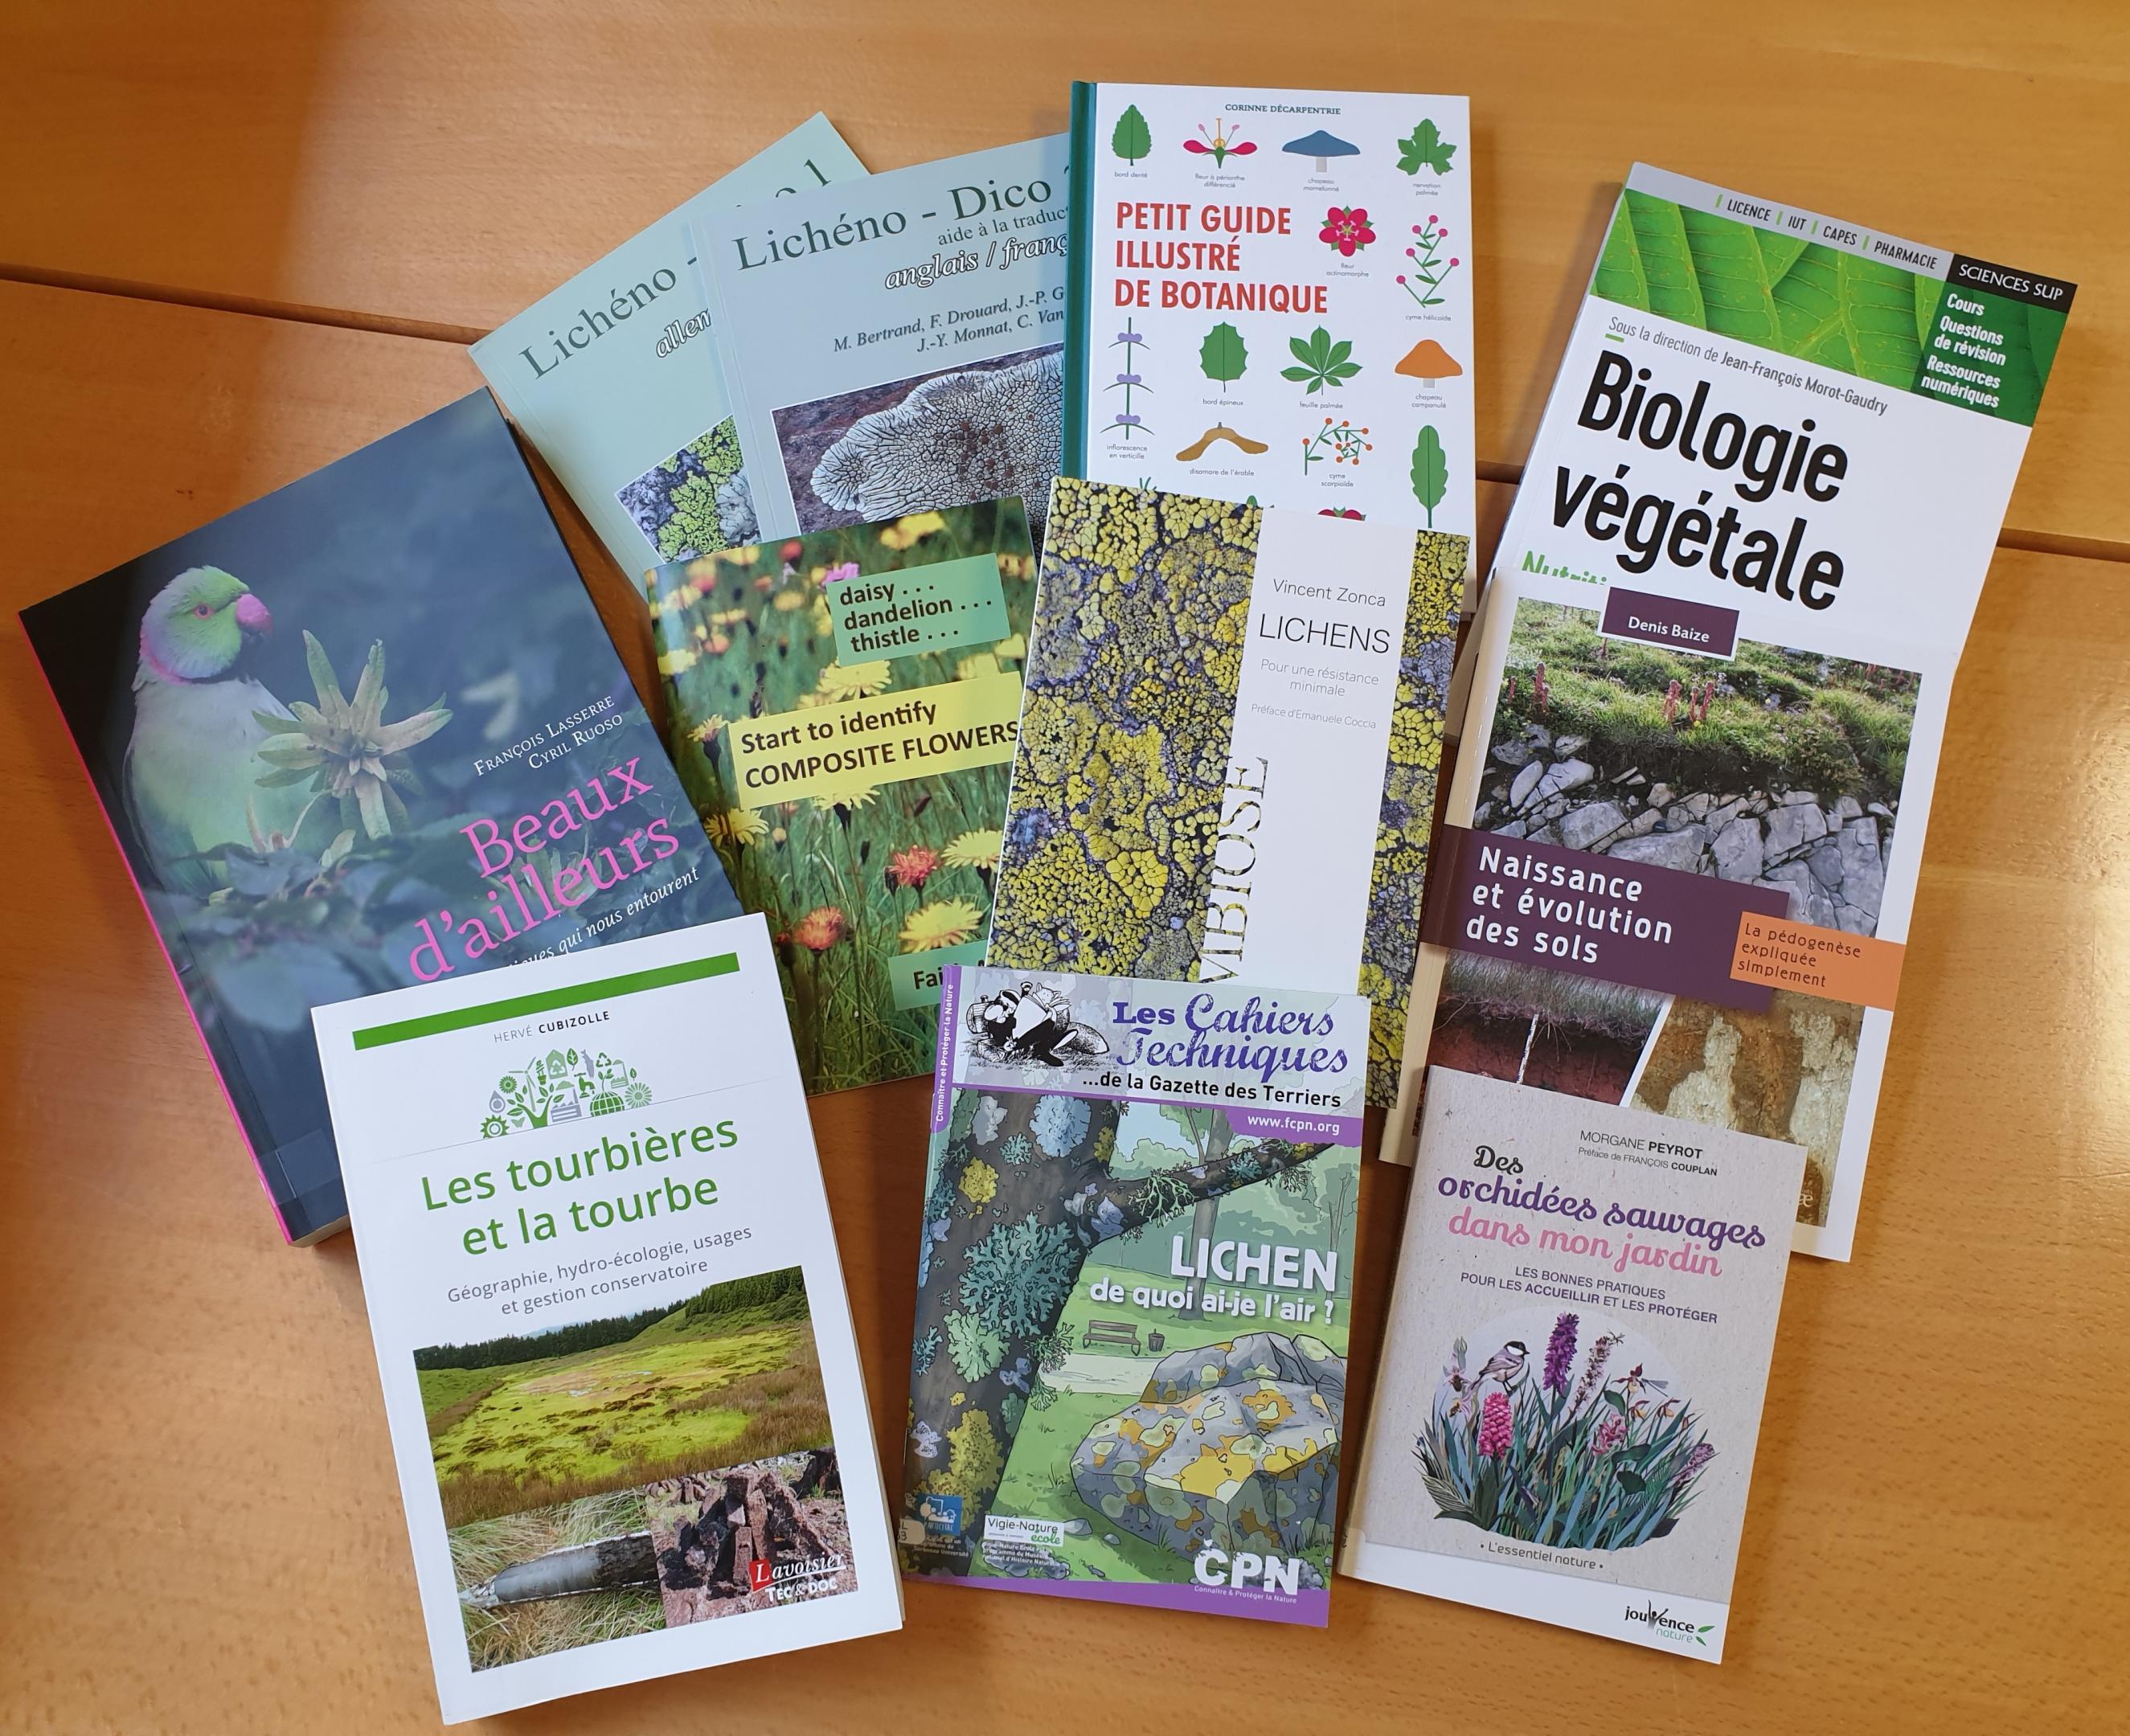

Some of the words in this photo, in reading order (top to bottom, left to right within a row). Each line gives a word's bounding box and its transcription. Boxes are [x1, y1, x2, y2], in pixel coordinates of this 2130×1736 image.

[1225, 103, 1268, 113] CORINNE
[1270, 102, 1341, 115] DÉCARPENTRIE
[731, 211, 906, 270] Lichéno
[947, 180, 1051, 220] Dico
[938, 227, 973, 245] aide
[978, 223, 988, 236] à
[993, 219, 1009, 233] la
[1116, 202, 1192, 231] PETIT
[1201, 205, 1292, 235] GUIDE
[1727, 199, 1772, 223] LICENCE
[1787, 215, 1807, 231] IUT
[1822, 224, 1858, 246] CAPES
[1874, 240, 1938, 269] PHARMACIE
[885, 250, 978, 289] anglais
[1116, 235, 1241, 272] ILLUSTRÉ
[1115, 279, 1150, 308] DE
[1161, 280, 1328, 313] BOTANIQUE
[1959, 263, 2030, 293] SCIENCES
[2033, 283, 2064, 301] SUP
[518, 264, 677, 379] Lichéno
[834, 338, 852, 352] M.
[856, 318, 925, 349] Bertrand,
[930, 314, 942, 329] F.
[948, 298, 1012, 324] Drouard,
[1016, 290, 1047, 309] J.-P.
[1947, 293, 1985, 316] Cours
[917, 334, 948, 352] J.-Y.
[954, 321, 1012, 344] Monnat,
[1017, 314, 1032, 329] C.
[1940, 315, 2004, 347] Questions
[1608, 317, 1636, 337] Sous
[1639, 325, 1650, 341] la
[1653, 329, 1702, 358] direction
[1704, 343, 1718, 361] de
[1720, 350, 1802, 389] Jean-François
[1804, 374, 1888, 416] Morot-Gaudry
[1933, 333, 1951, 349] de
[1953, 339, 2006, 367] révision
[1927, 354, 2001, 389] Ressources
[1920, 374, 2000, 410] numériques
[1577, 349, 1849, 502] Biologie
[1107, 444, 1148, 452] inflorescence
[1120, 452, 1145, 460] verticille
[1552, 463, 1845, 611] végétale
[839, 582, 895, 605] daisy
[1272, 579, 1332, 600] Vincent
[1336, 587, 1386, 607] Zonca
[844, 596, 953, 630] dandelion
[1628, 616, 1669, 637] Denis
[1672, 624, 1710, 644] Baize
[850, 625, 920, 653] thistle
[1260, 613, 1391, 654] LICHENS
[1260, 658, 1289, 675] Pour
[1292, 665, 1314, 678] une
[1317, 666, 1379, 686] résistance
[1289, 678, 1346, 698] minimale
[741, 722, 801, 754] Start
[807, 722, 834, 742] to
[840, 700, 937, 736] identify
[1251, 704, 1286, 718] Préface
[1345, 716, 1377, 729] Coccia
[745, 743, 896, 788] COMPOSITE
[903, 722, 1019, 761] FLOWERS
[460, 756, 653, 879] Beaux
[1479, 845, 1643, 902] Naissance
[408, 817, 679, 981] d'ailleurs
[559, 927, 583, 954] qui
[586, 910, 623, 937] nous
[627, 866, 699, 916] entourent
[1473, 882, 1504, 910] et
[1518, 888, 1672, 944] évolution
[1466, 915, 1519, 948] des
[1533, 927, 1599, 964] sols
[1741, 940, 1817, 969] expliquée
[1744, 923, 1761, 939] La
[1768, 925, 1861, 960] pédogenèse
[1738, 959, 1827, 989] simplement
[493, 1025, 533, 1043] HERVÉ
[538, 1009, 611, 1034] CUBIZOLLE
[1112, 1001, 1175, 1025] Les
[1184, 993, 1333, 1037] Cahiers
[1116, 1028, 1348, 1083] Techniques
[1126, 1073, 1145, 1090] la
[1149, 1076, 1219, 1096] Gazette
[1223, 1080, 1257, 1099] des
[1263, 1085, 1341, 1108] Terriers
[1247, 1114, 1340, 1136] www.fcpn.org
[1473, 1145, 1524, 1175] Des
[1578, 1147, 1608, 1161] Préface
[1611, 1152, 1621, 1161] de
[1624, 1154, 1669, 1169] FRANÇOIS
[1671, 1161, 1718, 1177] COUPLAN
[1580, 1130, 1645, 1152] MORGANE
[1649, 1141, 1703, 1160] PEYROT
[421, 1168, 496, 1211] Les
[506, 1119, 739, 1189] tourbières
[462, 1220, 508, 1255] et
[518, 1207, 557, 1245] la
[568, 1176, 719, 1234] tourbe
[1438, 1175, 1597, 1222] orchidées
[1604, 1202, 1766, 1252] sauvages
[1448, 1206, 1530, 1247] dans
[1539, 1229, 1612, 1260] mon
[1613, 1234, 1722, 1277] jardin
[447, 1269, 554, 1306] Géographie,
[557, 1243, 690, 1287] hydro-écologie,
[693, 1225, 752, 1255] usages
[1170, 1235, 1337, 1292] LICHEN
[502, 1299, 519, 1316] et
[522, 1284, 587, 1314] gestion
[590, 1259, 709, 1296] conservatoire
[1090, 1277, 1125, 1302] de
[1133, 1283, 1194, 1312] quoi
[1202, 1288, 1257, 1316] ai-je
[1460, 1271, 1496, 1288] POUR
[1499, 1278, 1522, 1292] LES
[1525, 1281, 1600, 1304] ACCUEILLIR
[1603, 1294, 1619, 1308] ET
[1622, 1297, 1645, 1312] LES
[1648, 1302, 1718, 1325] PROTÉGER
[1514, 1266, 1538, 1280] LES
[1541, 1270, 1594, 1288] BONNES
[1596, 1279, 1666, 1301] PRATIQUES
[988, 1517, 1058, 1533] Vigie-Nature
[756, 1552, 844, 1583] Lavoisier
[1194, 1546, 1300, 1595] CPN
[1488, 1541, 1552, 1562] L'essentiel
[1554, 1554, 1597, 1570] nature
[808, 1579, 837, 1594] DOC
[1656, 1628, 1693, 1644] nature
